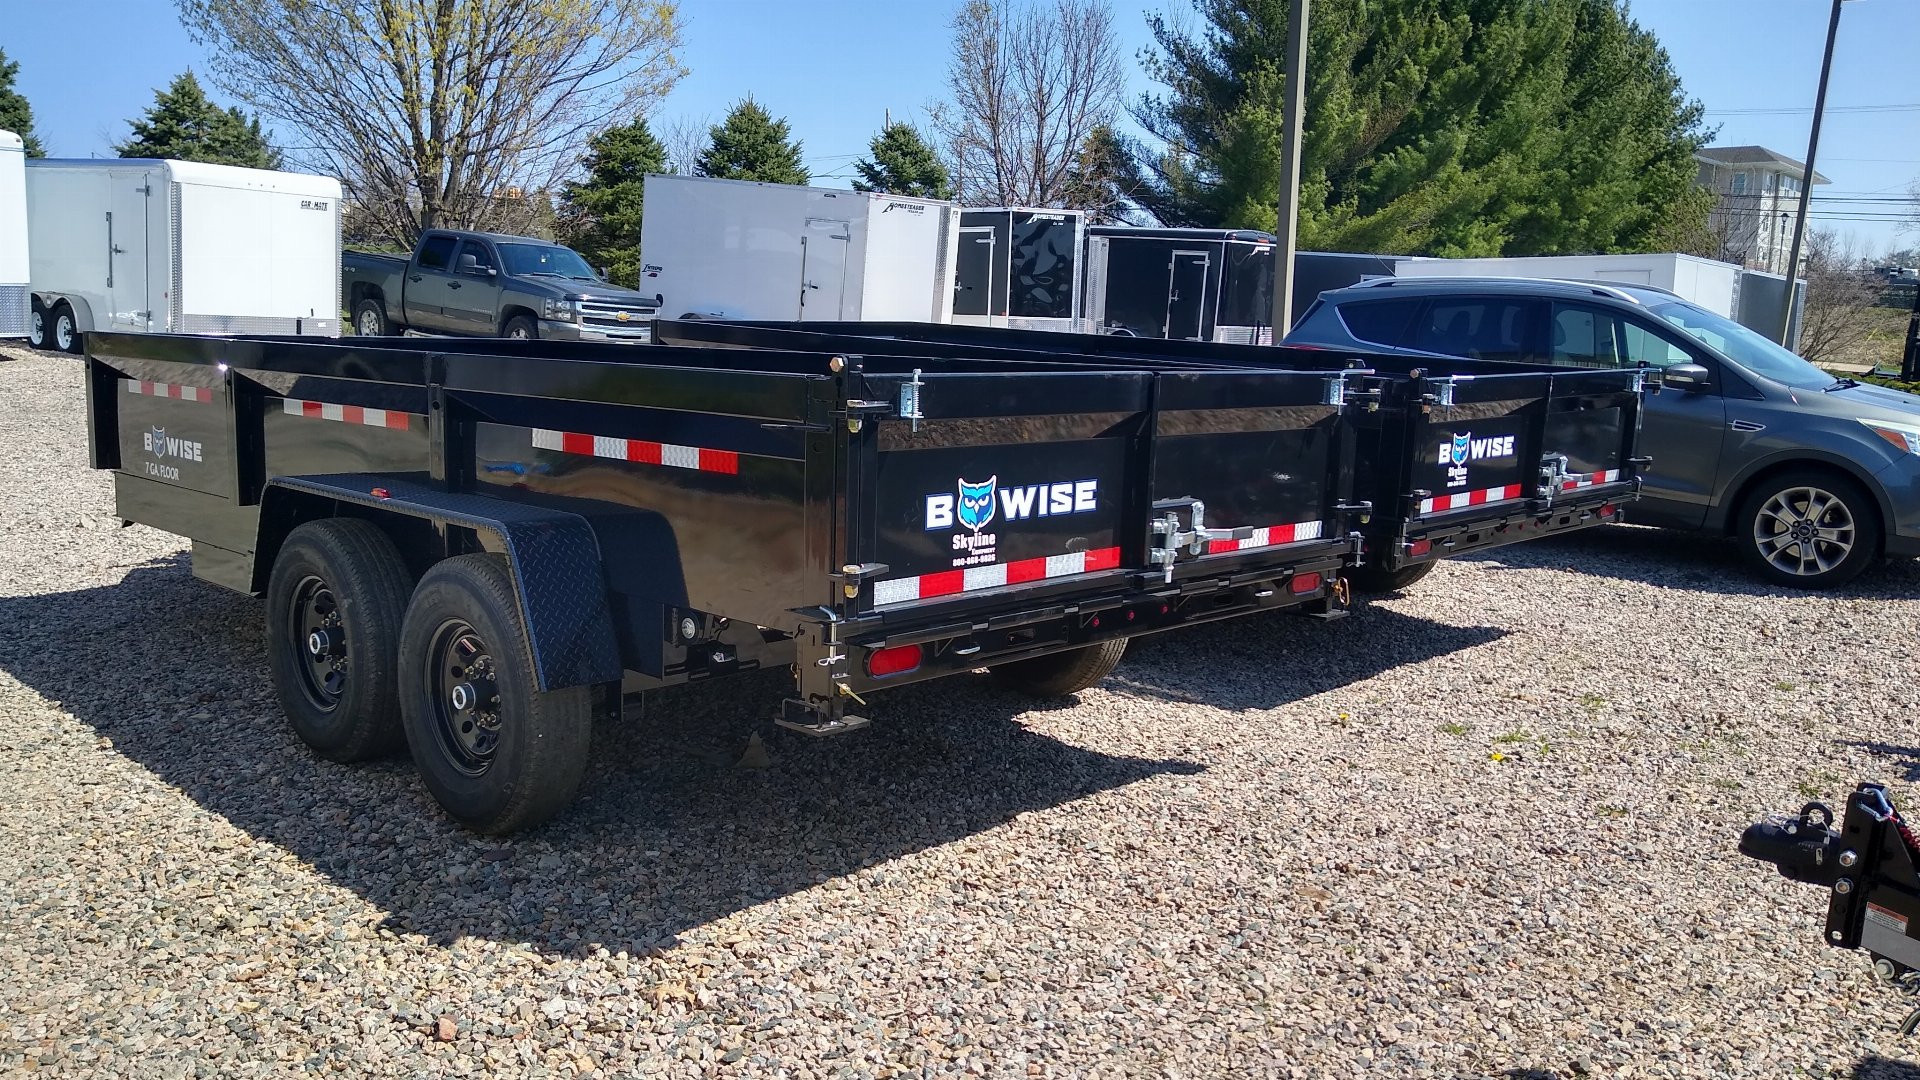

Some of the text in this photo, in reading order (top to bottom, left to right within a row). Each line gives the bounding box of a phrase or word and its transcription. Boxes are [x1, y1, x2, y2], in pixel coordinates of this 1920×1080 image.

[145, 461, 149, 474] 7
[160, 464, 180, 481] FLOOR
[952, 531, 996, 552] Skyline
